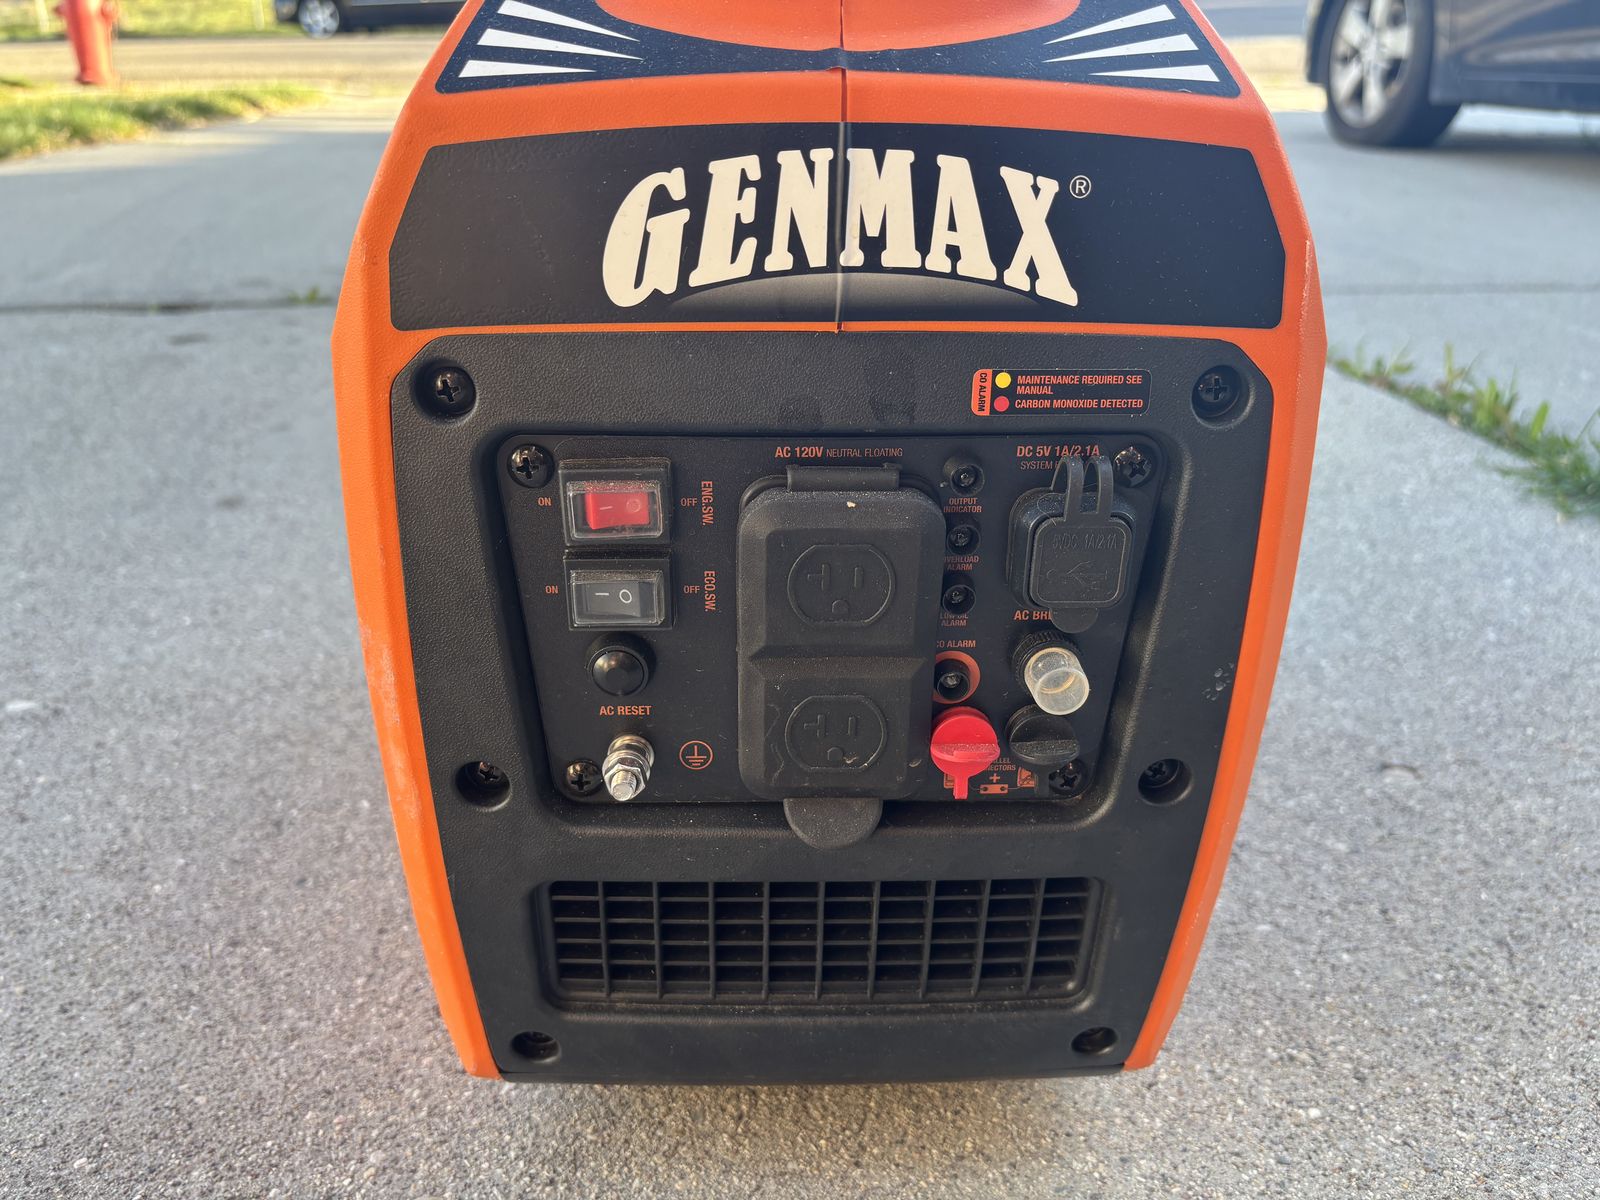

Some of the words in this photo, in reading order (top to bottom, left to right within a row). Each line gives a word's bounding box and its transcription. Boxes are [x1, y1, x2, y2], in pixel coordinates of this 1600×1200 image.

[602, 147, 1078, 307] GENMAX
[979, 372, 988, 382] CO
[1017, 375, 1080, 385] MAINTENANCE
[1081, 375, 1124, 385] REQUIRED
[1126, 375, 1142, 385] SEE
[1016, 386, 1053, 395] MANUAL
[978, 384, 988, 412] ALARM
[1015, 399, 1051, 408] CARBON
[1053, 399, 1098, 408] MONOXIDE
[1100, 399, 1143, 408] DETECTED
[775, 446, 791, 458] AC
[795, 446, 824, 458] 120V
[826, 448, 861, 458] NEUTRAL
[864, 447, 903, 457] FLOATING
[1016, 445, 1033, 457] DC
[1036, 445, 1052, 457] 5V
[1055, 444, 1100, 457] 1A/2.1A
[1020, 460, 1053, 470] SYSTEM
[538, 497, 552, 507] ON
[680, 498, 698, 507] OFF
[949, 497, 978, 505] OUTPUT
[943, 505, 982, 513] INDICATOR
[947, 563, 973, 571] ALARM
[545, 585, 559, 595] ON
[683, 585, 700, 594] OFF
[1013, 609, 1030, 621] AC
[941, 619, 967, 627] ALARM
[947, 639, 976, 648] ALARM
[600, 705, 614, 716] AC
[617, 705, 652, 716] RESET
